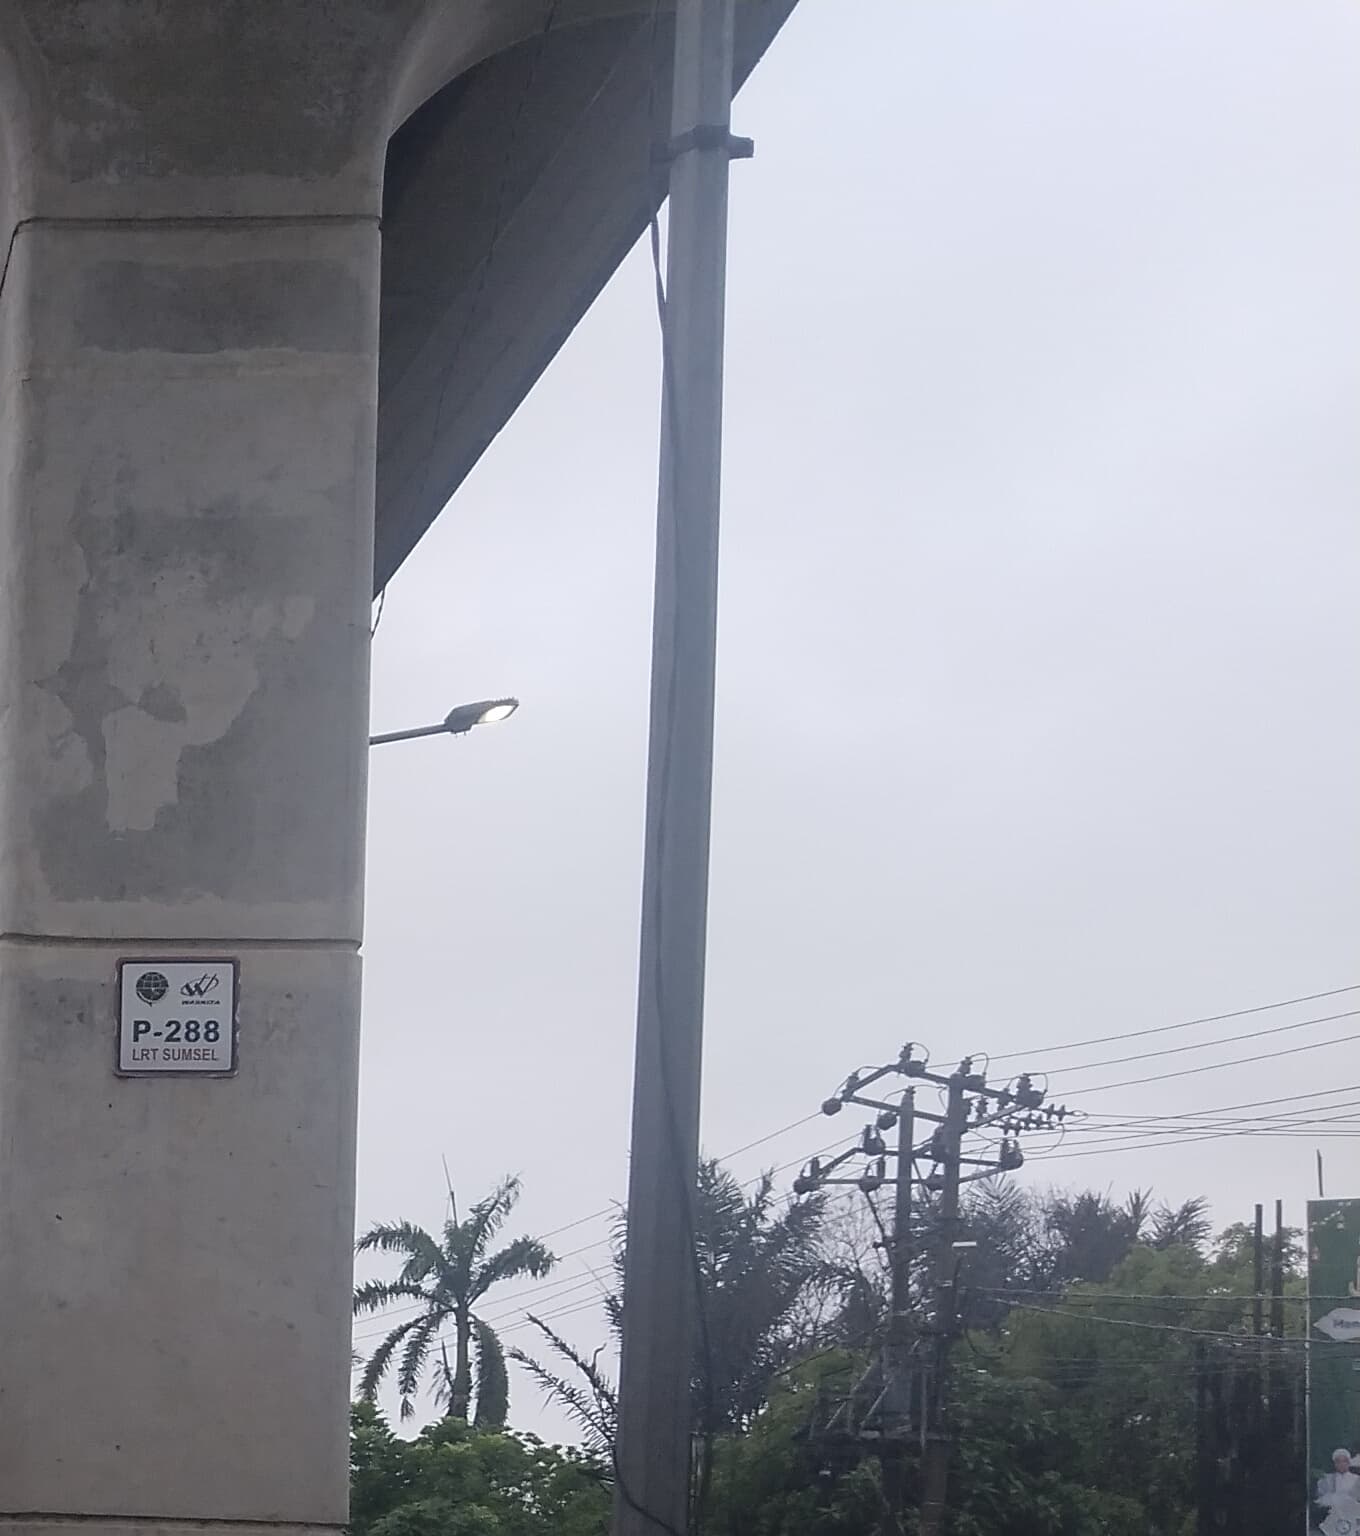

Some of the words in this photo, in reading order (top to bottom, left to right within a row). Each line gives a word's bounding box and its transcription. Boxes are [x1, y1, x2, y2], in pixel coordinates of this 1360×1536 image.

[132, 1020, 220, 1043] P-288
[132, 1048, 159, 1061] LRT
[162, 1048, 219, 1061] SUMSEL
